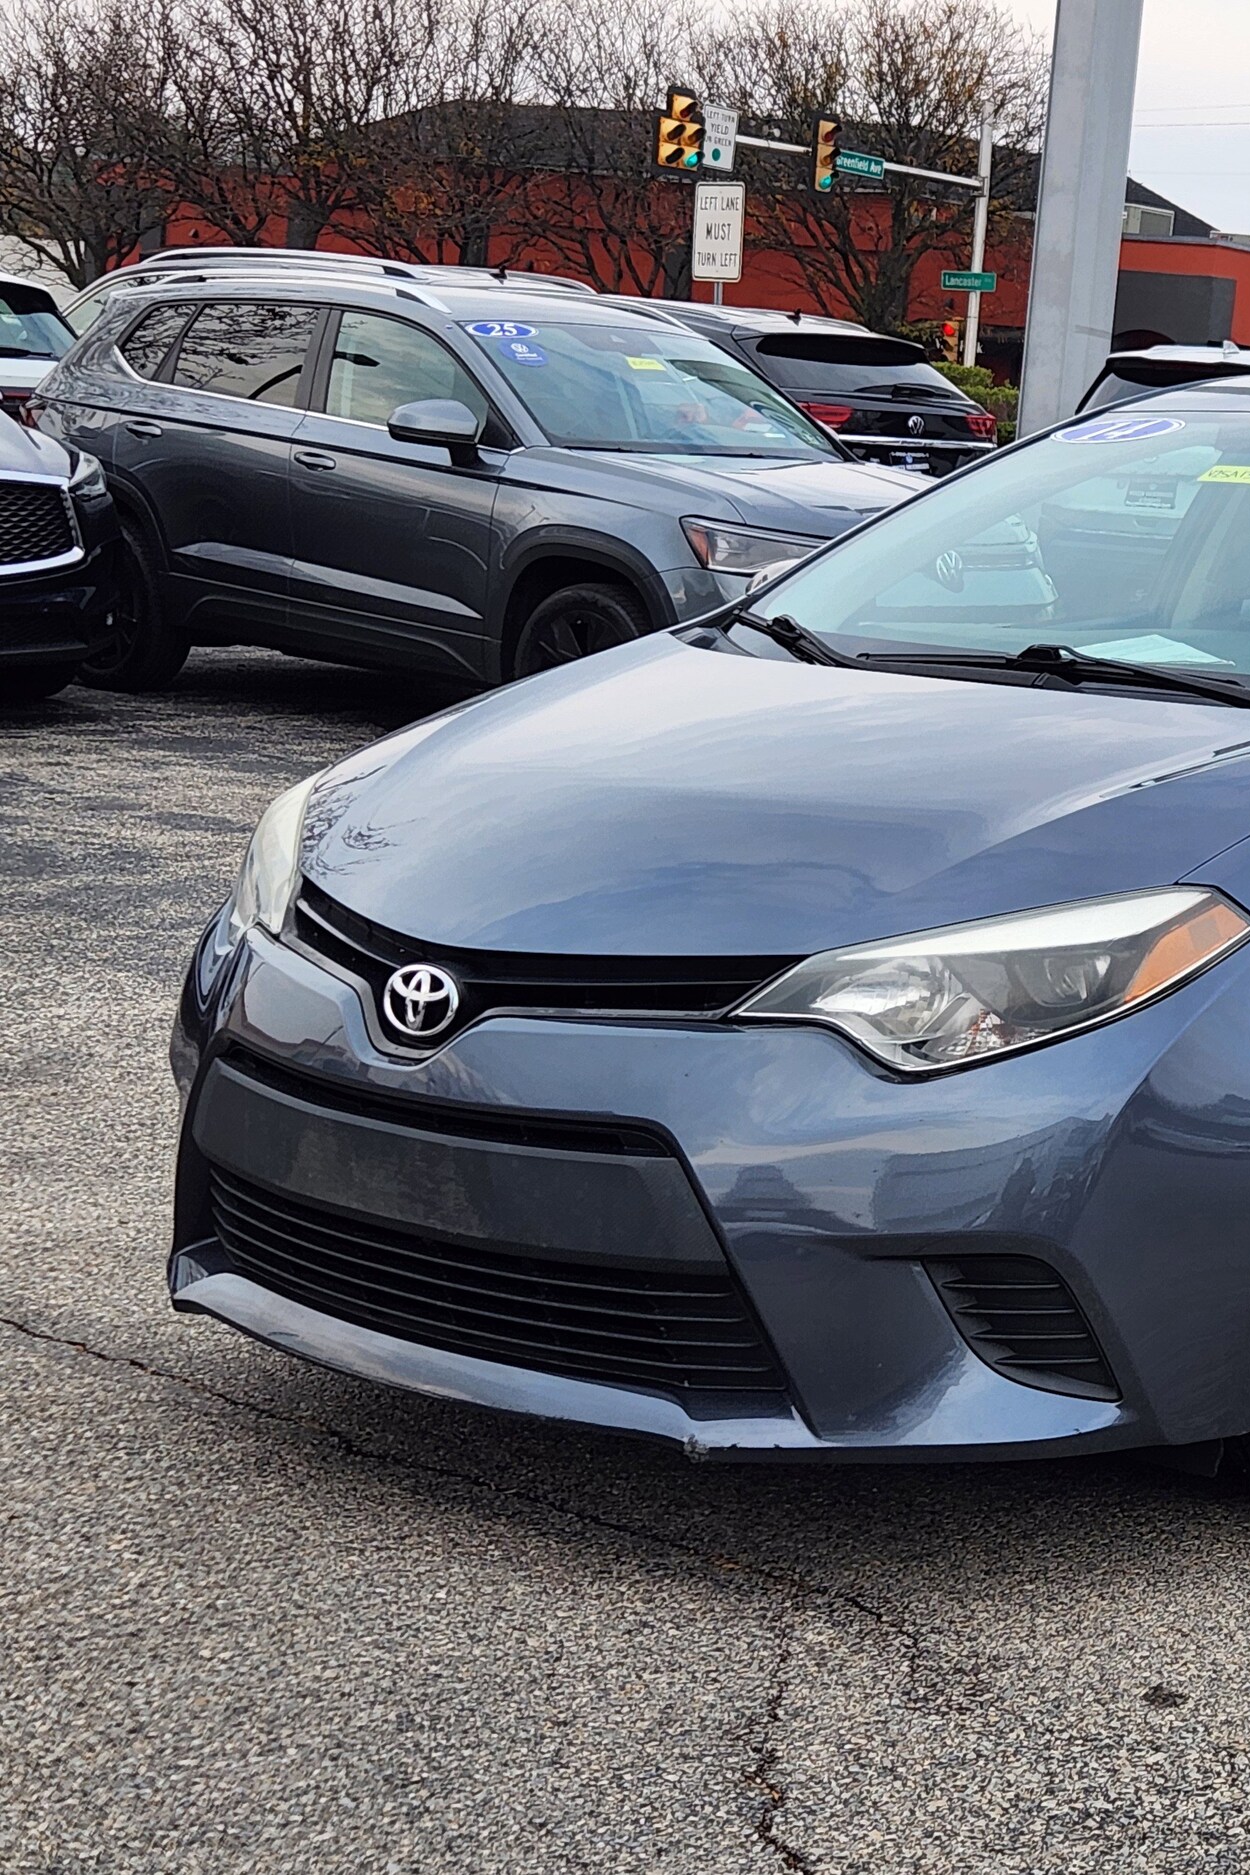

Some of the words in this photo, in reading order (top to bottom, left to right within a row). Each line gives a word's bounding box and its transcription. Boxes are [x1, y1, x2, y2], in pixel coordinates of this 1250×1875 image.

[706, 110, 720, 120] LEFT
[721, 113, 735, 123] TURN
[711, 123, 730, 135] YIELD
[714, 136, 732, 147] GREEN
[870, 160, 882, 174] Ave
[700, 196, 718, 210] LEFT
[721, 196, 740, 211] LANE
[705, 222, 731, 241] MUST
[697, 251, 717, 267] TURN
[720, 252, 738, 267] LEFT
[945, 274, 982, 287] Lancaster
[486, 323, 518, 336] 25
[1071, 418, 1166, 441] 14
